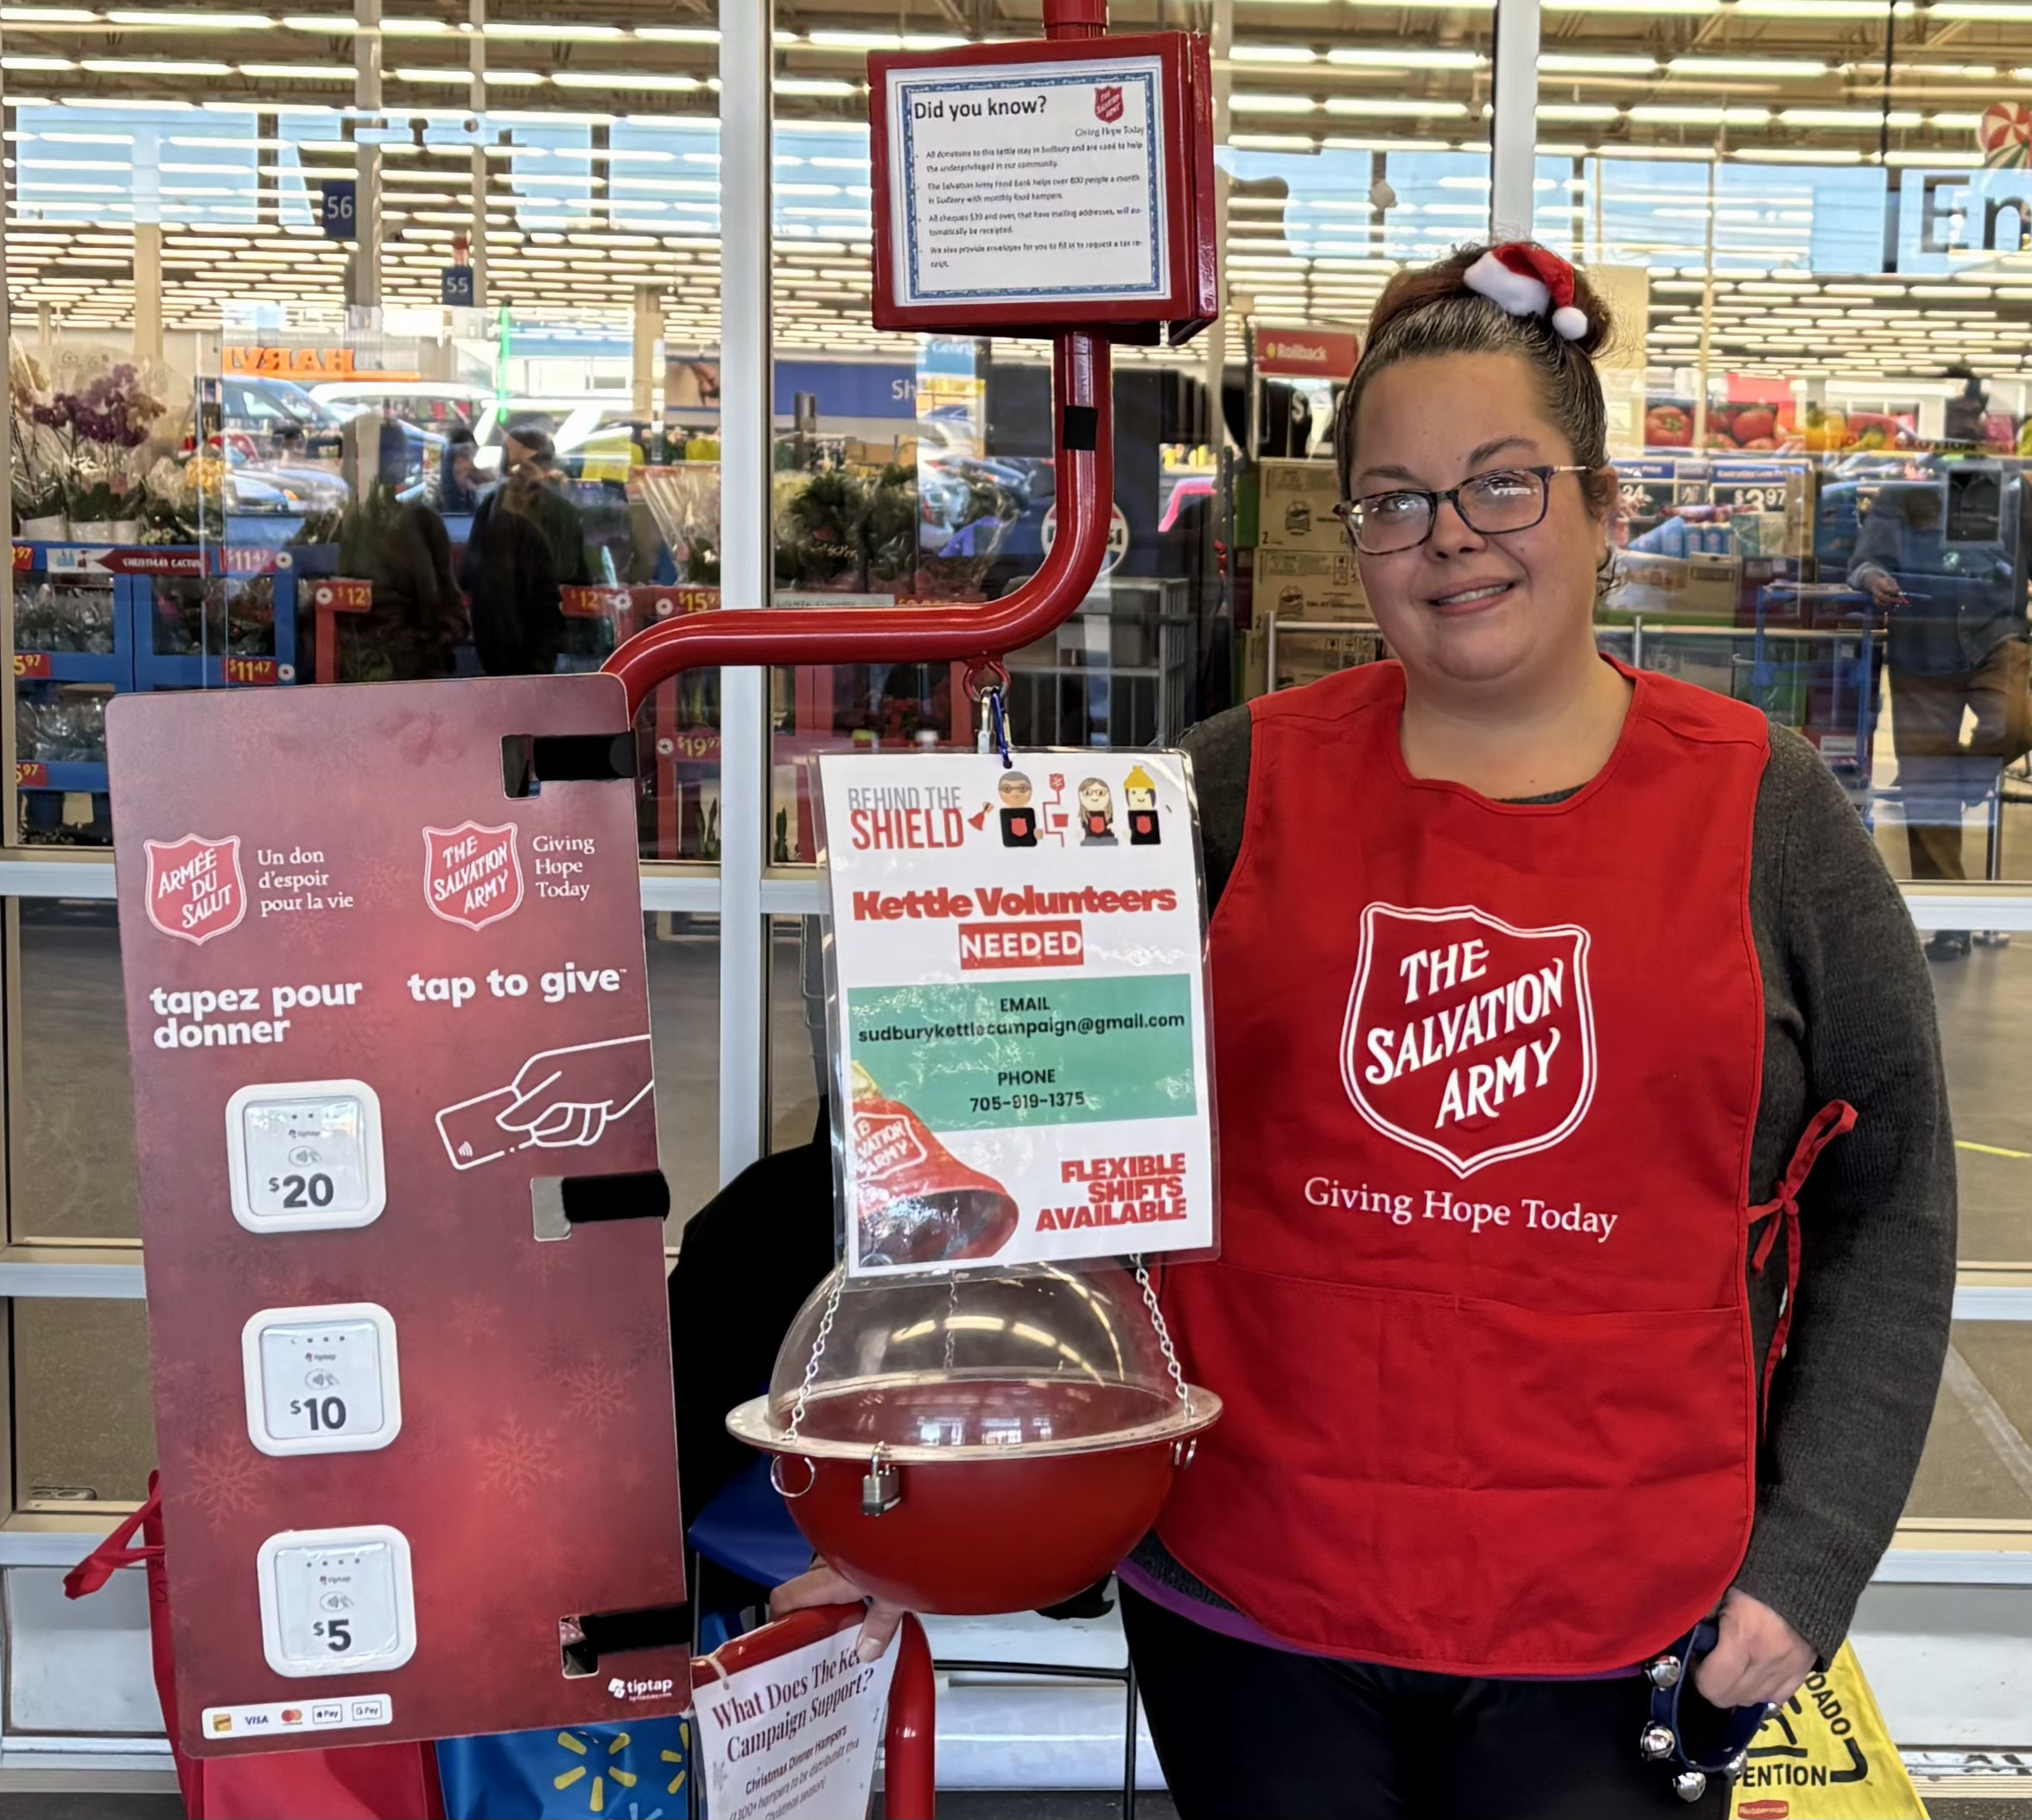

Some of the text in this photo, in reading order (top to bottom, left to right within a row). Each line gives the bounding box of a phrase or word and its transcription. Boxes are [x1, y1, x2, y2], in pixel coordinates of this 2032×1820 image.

[914, 95, 1047, 122] Did you know?
[327, 195, 352, 219] 56
[446, 276, 469, 293] 55
[848, 786, 962, 811] BEHIND THE
[532, 835, 595, 855] Giving
[850, 808, 964, 850] SHIELD
[258, 847, 325, 866] Un don
[442, 835, 478, 868] THE
[157, 847, 217, 899] ARMÉE
[434, 841, 508, 901] SALVATION
[536, 859, 583, 878] Hope
[192, 871, 218, 901] DU
[464, 869, 509, 914] ARMY
[536, 882, 589, 901] Today
[181, 884, 232, 929] SALUT
[261, 891, 353, 917] pour la vie
[853, 885, 1177, 921] Kettle Volunteers
[962, 930, 1082, 958] NEEDED
[1400, 938, 1489, 1005] THE
[149, 979, 363, 1020] tapez pour
[408, 973, 476, 1008] tap
[486, 968, 529, 998] to
[1000, 997, 1051, 1012] EMAIL
[153, 1018, 290, 1050] donner
[858, 1013, 1184, 1043] sudburykettlecampaign@gmail.com
[1364, 957, 1565, 1085] SALVATION
[998, 1069, 1056, 1086] PHONE
[1434, 1026, 1561, 1130] ARMY
[969, 1091, 1085, 1113] 705-919-1375
[1060, 1153, 1185, 1183] FLEXIBLE
[269, 1172, 334, 1208] $20
[1088, 1176, 1184, 1203] SHIFTS
[1036, 1198, 1187, 1232] AVAILABLE
[1305, 1177, 1618, 1244] Giving Hope Today
[290, 1396, 346, 1431] $10
[313, 1618, 352, 1652] $5
[627, 1679, 673, 1696] tiptap
[712, 1696, 765, 1730] What
[765, 1676, 808, 1709] Does
[812, 1659, 837, 1690] The
[245, 1715, 269, 1725] VISA
[324, 1709, 339, 1719] Pay
[364, 1706, 378, 1716] Pay
[727, 1667, 874, 1763] Campaign Support?
[1805, 1673, 1851, 1735] DADO
[746, 1725, 848, 1796] Christmas Dinner Hampers
[1735, 1763, 1826, 1787] ENTION
[791, 1779, 798, 1791] to
